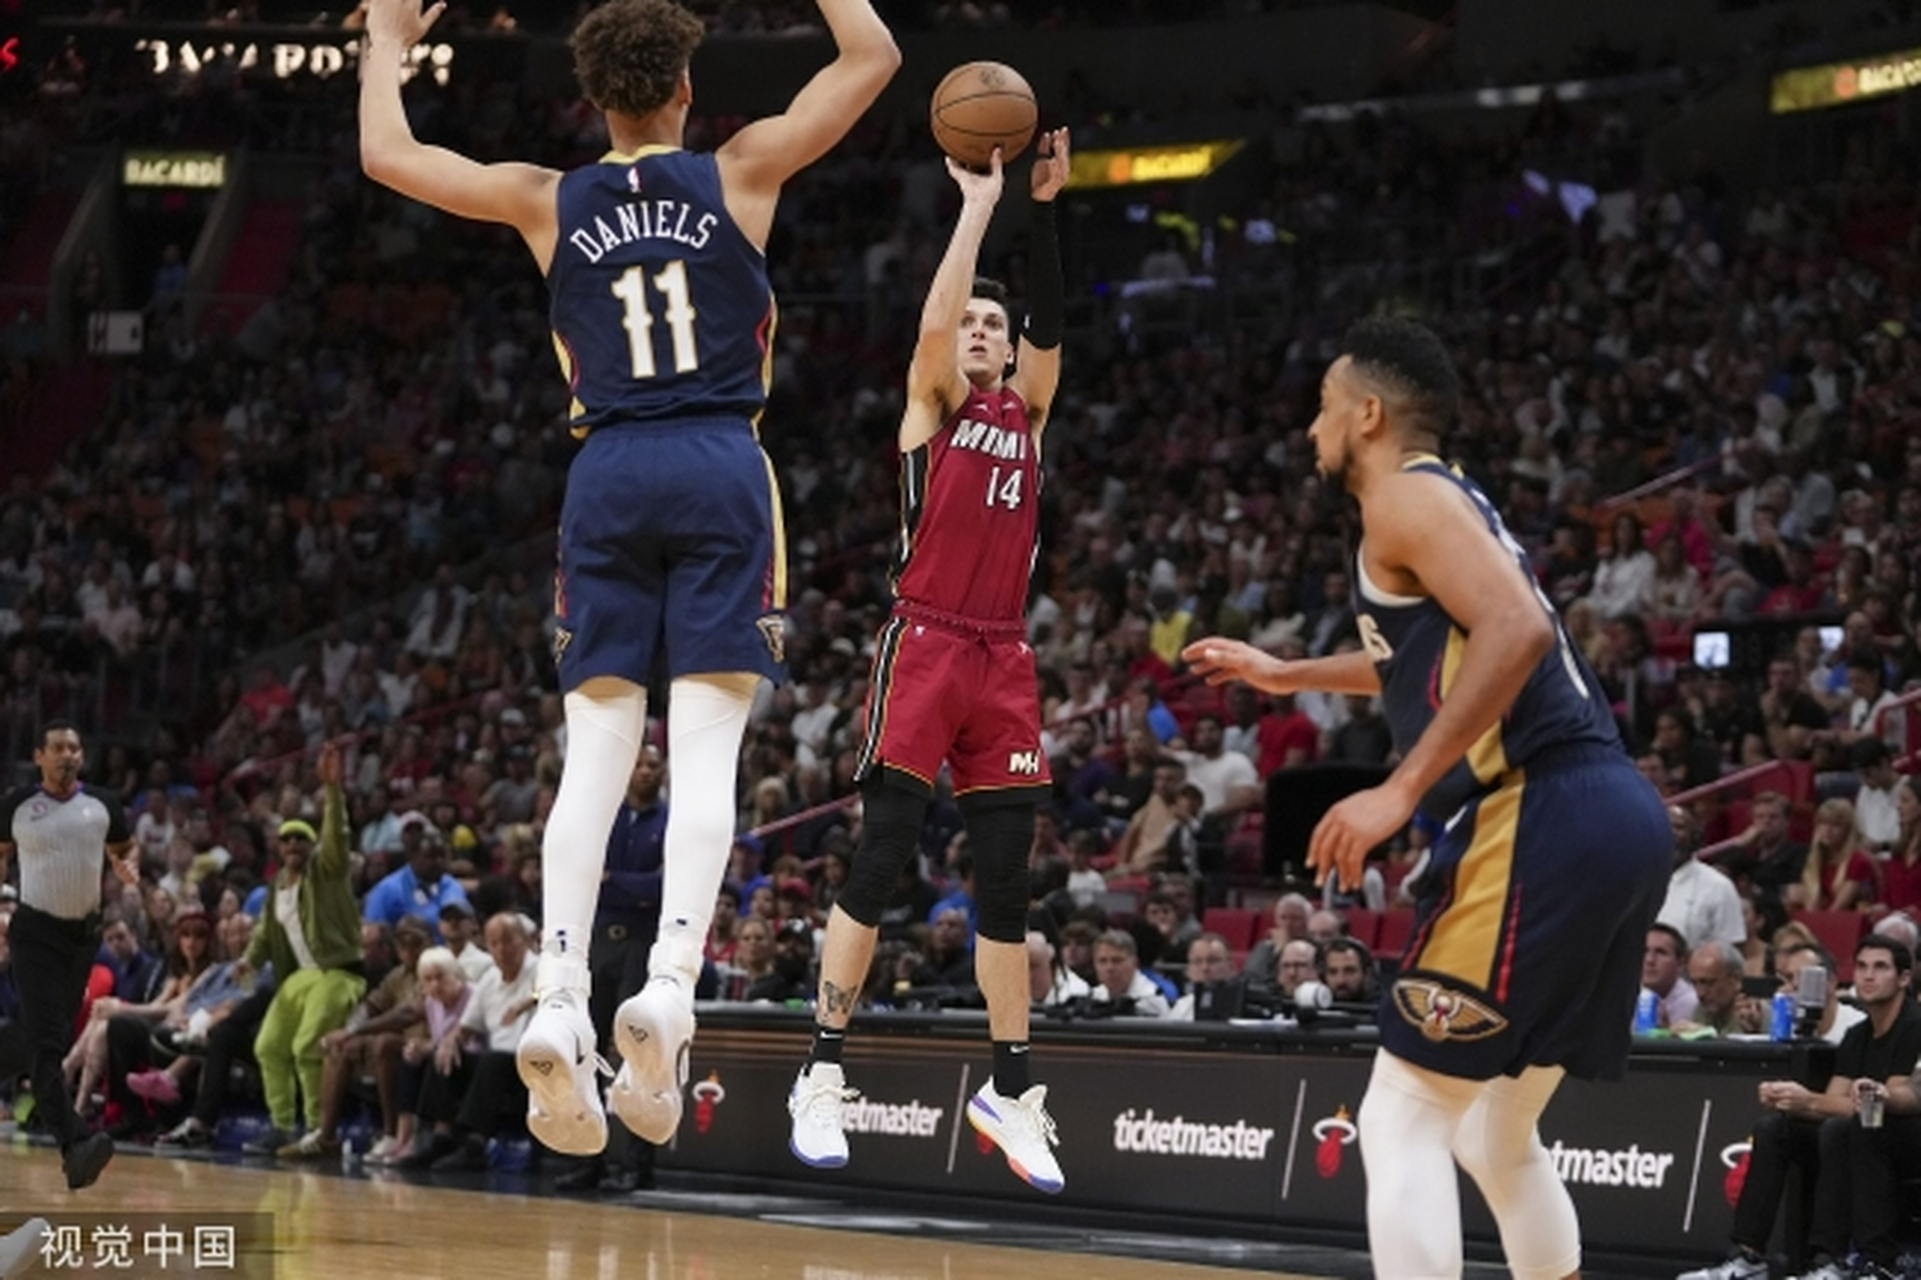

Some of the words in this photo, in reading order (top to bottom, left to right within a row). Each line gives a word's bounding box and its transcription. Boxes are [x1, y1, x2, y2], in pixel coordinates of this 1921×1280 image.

[570, 200, 718, 264] DANIELS
[611, 259, 698, 379] 11
[986, 466, 1023, 510] 14
[1113, 1108, 1275, 1160] ticketmaster
